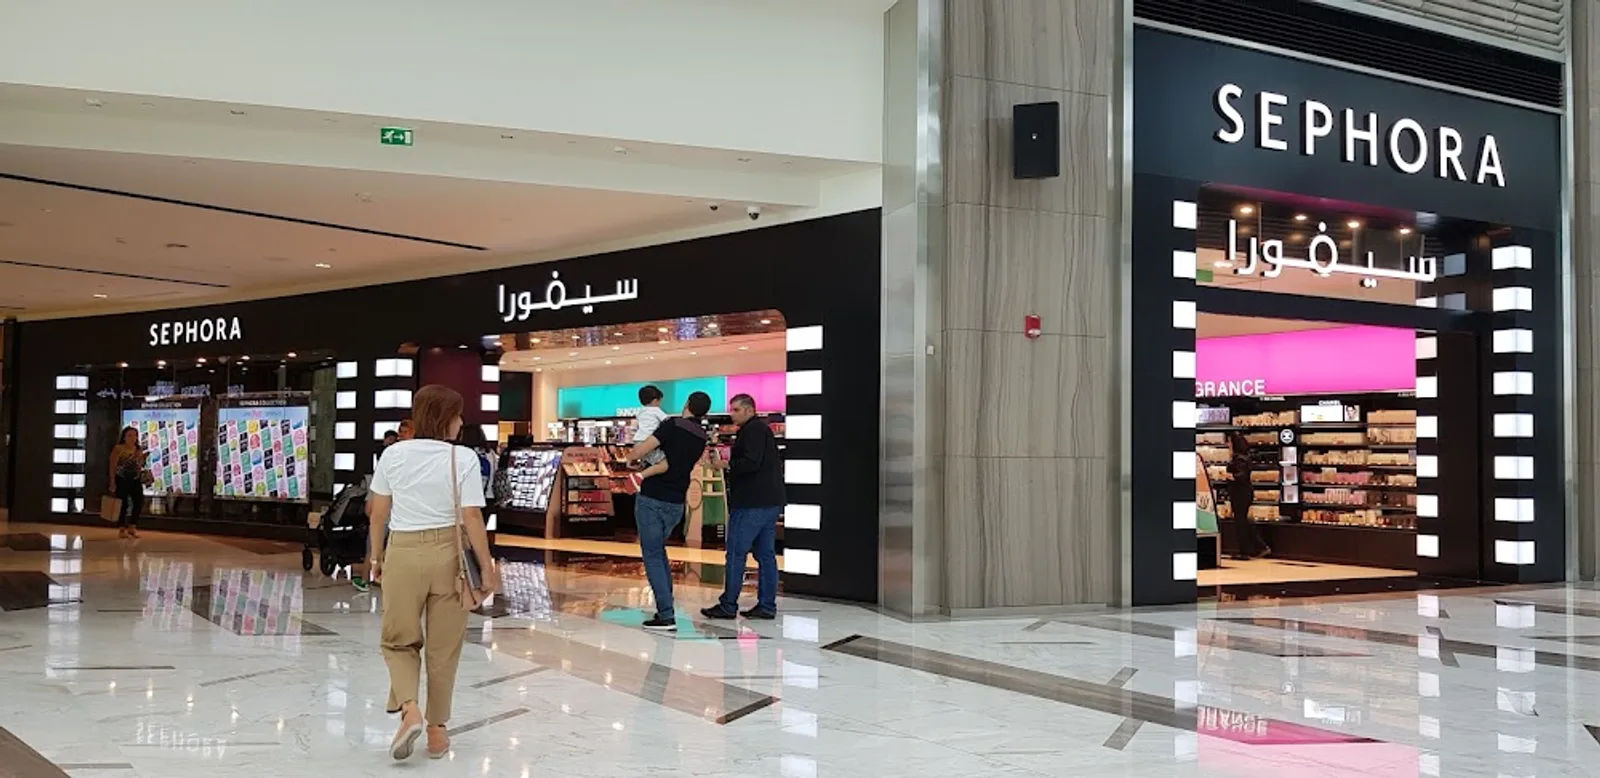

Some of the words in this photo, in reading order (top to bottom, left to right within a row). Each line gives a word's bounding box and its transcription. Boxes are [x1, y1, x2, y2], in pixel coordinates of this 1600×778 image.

[1215, 83, 1506, 187] SEPHORA
[1227, 219, 1438, 289] سيفورا
[497, 270, 639, 322] سيفورا
[149, 316, 242, 346] SEPHORA
